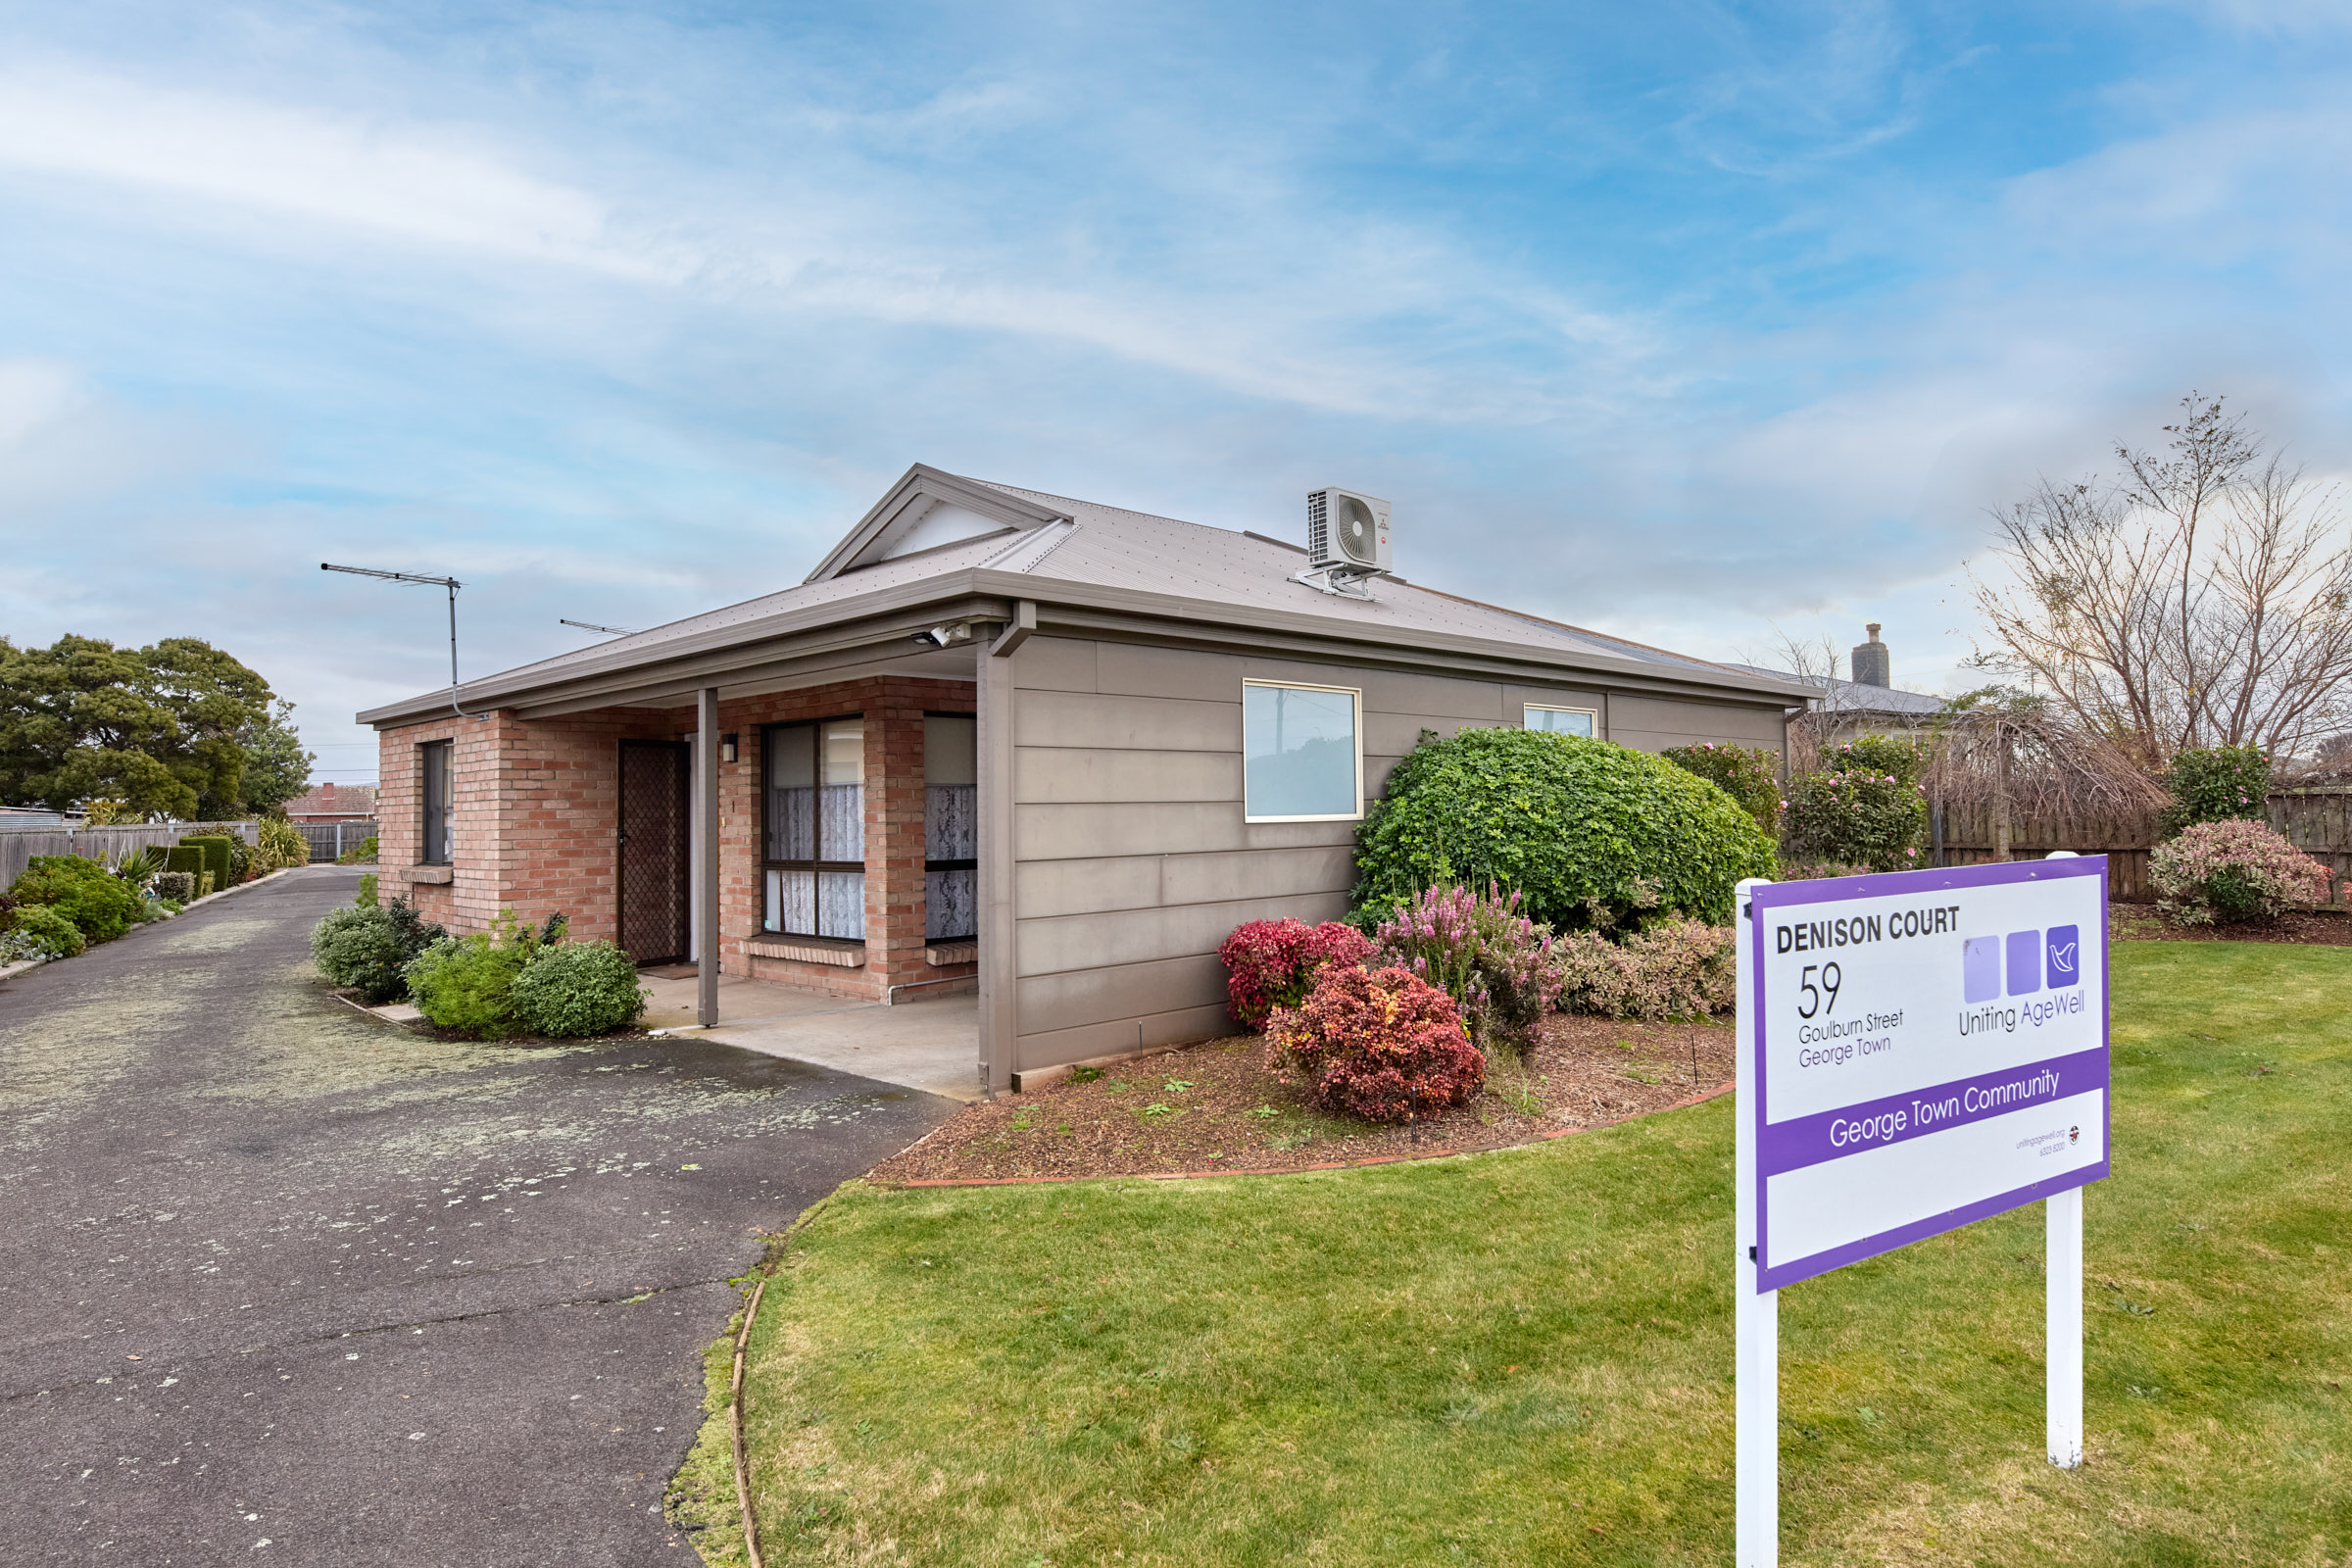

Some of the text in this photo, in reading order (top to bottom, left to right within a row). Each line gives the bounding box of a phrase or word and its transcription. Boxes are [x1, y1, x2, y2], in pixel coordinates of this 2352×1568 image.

[1777, 906, 1959, 954] DENISON COURT
[1797, 961, 1841, 1019] 59
[1959, 989, 2084, 1036] Uniting AgeWell
[1799, 1007, 1903, 1045] Goulburn Street
[1799, 1037, 1891, 1067] George Town
[1830, 1069, 2060, 1148] George Town Community
